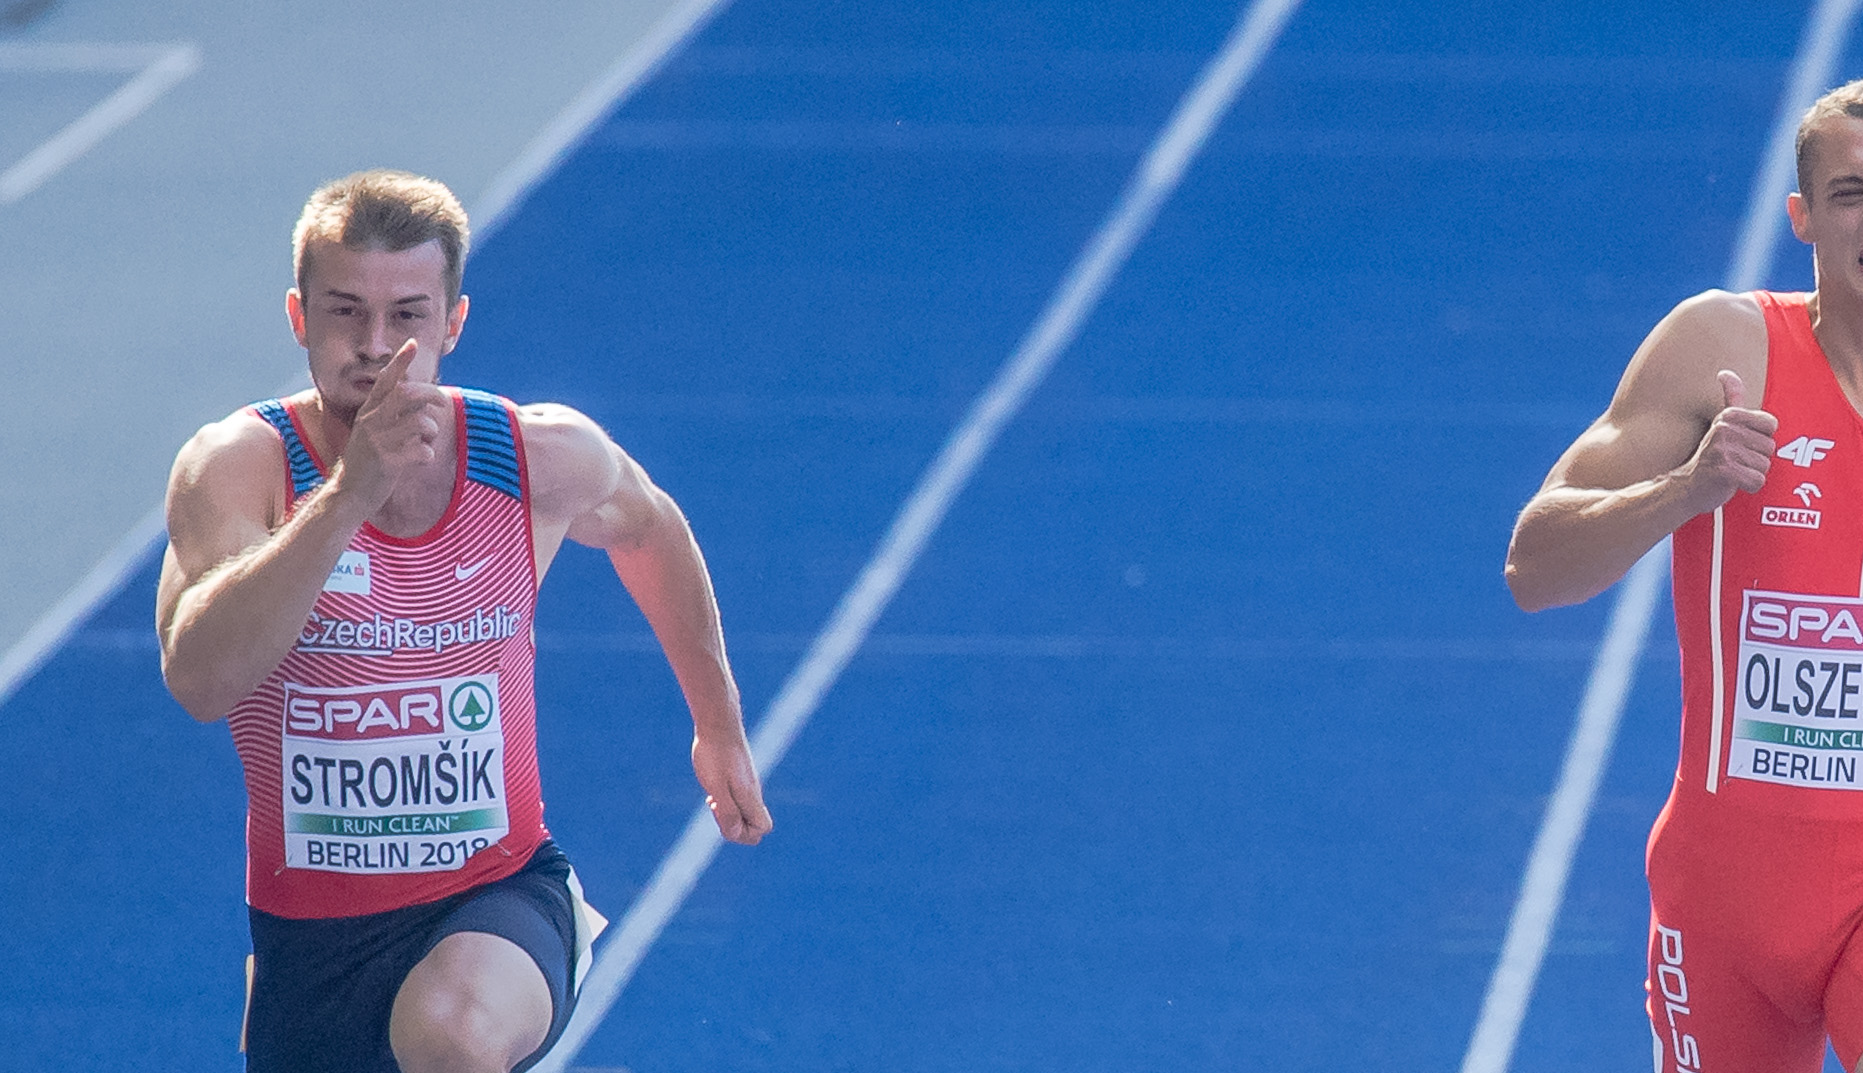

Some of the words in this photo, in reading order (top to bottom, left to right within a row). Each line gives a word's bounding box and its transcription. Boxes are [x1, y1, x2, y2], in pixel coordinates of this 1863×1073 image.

[1777, 436, 1835, 468] 4F
[1765, 510, 1818, 526] ORLEN
[289, 693, 440, 733] SPAR
[1783, 727, 1789, 742] I
[1794, 728, 1835, 746] RUN
[290, 738, 496, 808] STROMŠÍK
[1752, 748, 1856, 783] BERLIN
[332, 818, 338, 834] I
[343, 817, 382, 834] RUN
[307, 841, 409, 868] BERLIN
